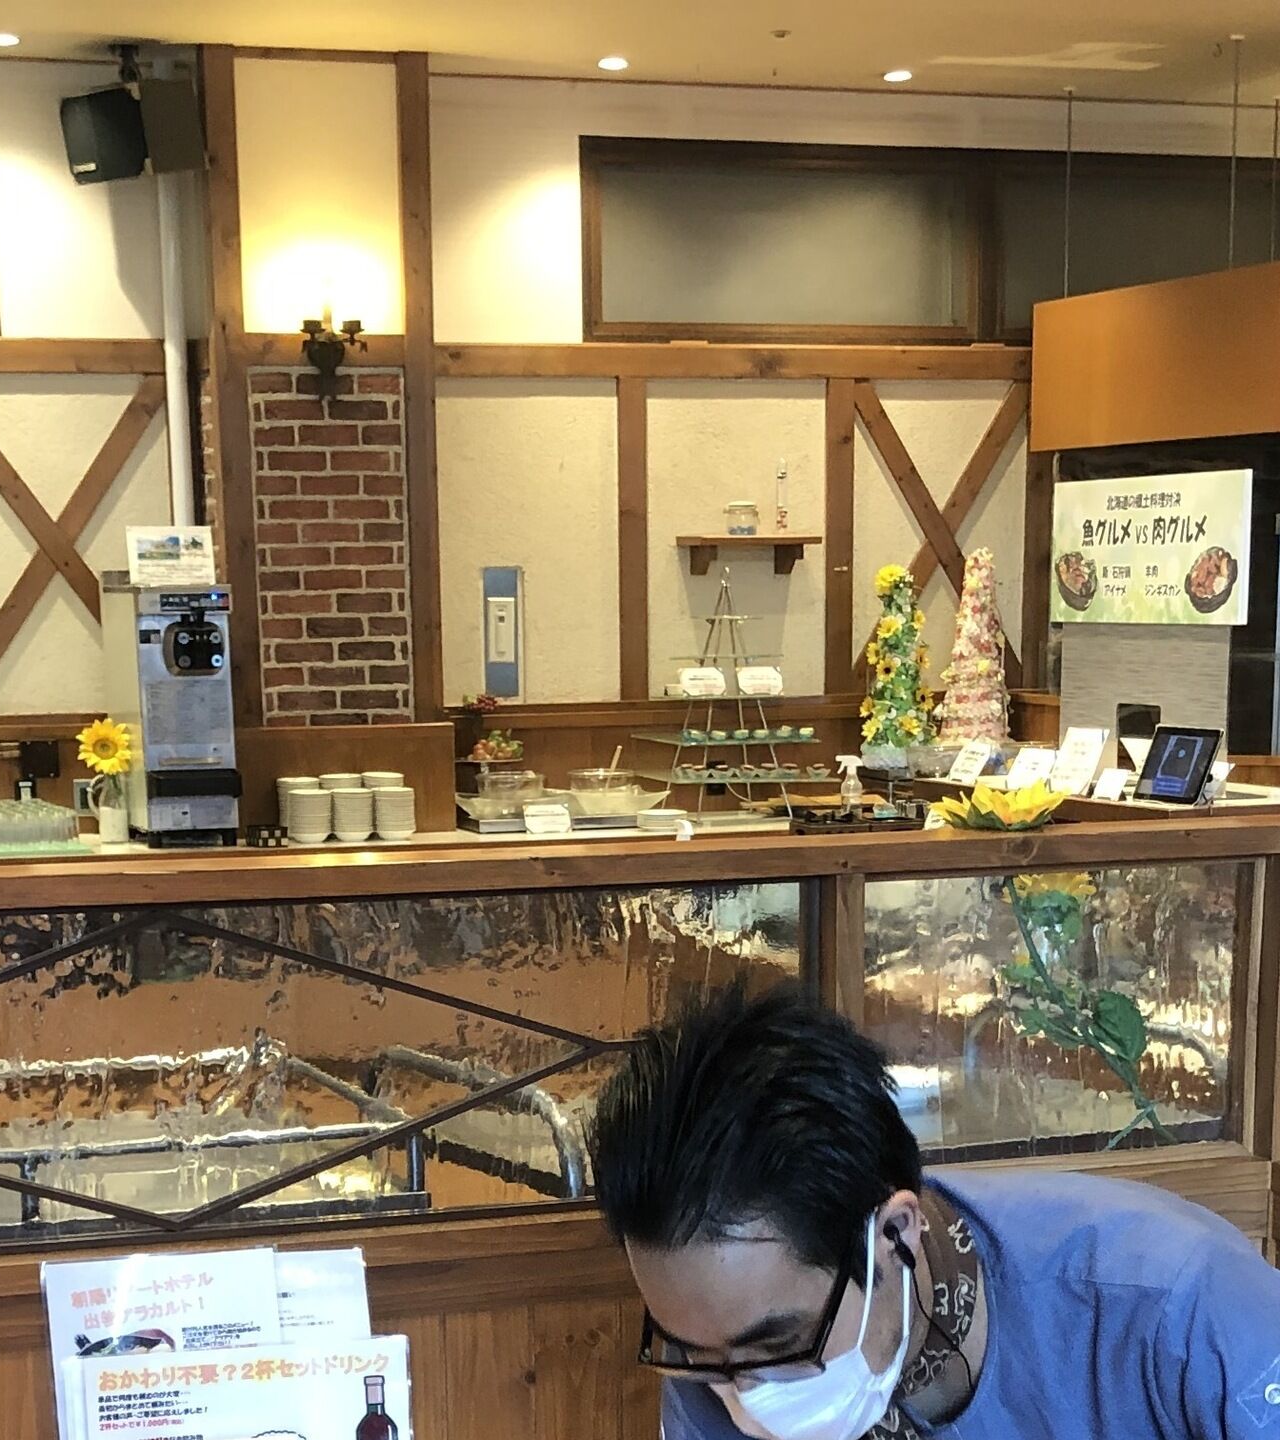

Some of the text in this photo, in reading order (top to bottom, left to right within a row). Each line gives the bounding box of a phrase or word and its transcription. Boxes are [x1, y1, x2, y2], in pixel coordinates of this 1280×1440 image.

[1107, 492, 1181, 511] 北海道の郷土料理対決
[1081, 518, 1132, 547] 魚グルメ
[1152, 514, 1207, 546] 肉グルメ
[1145, 584, 1181, 597] ジンギスカン
